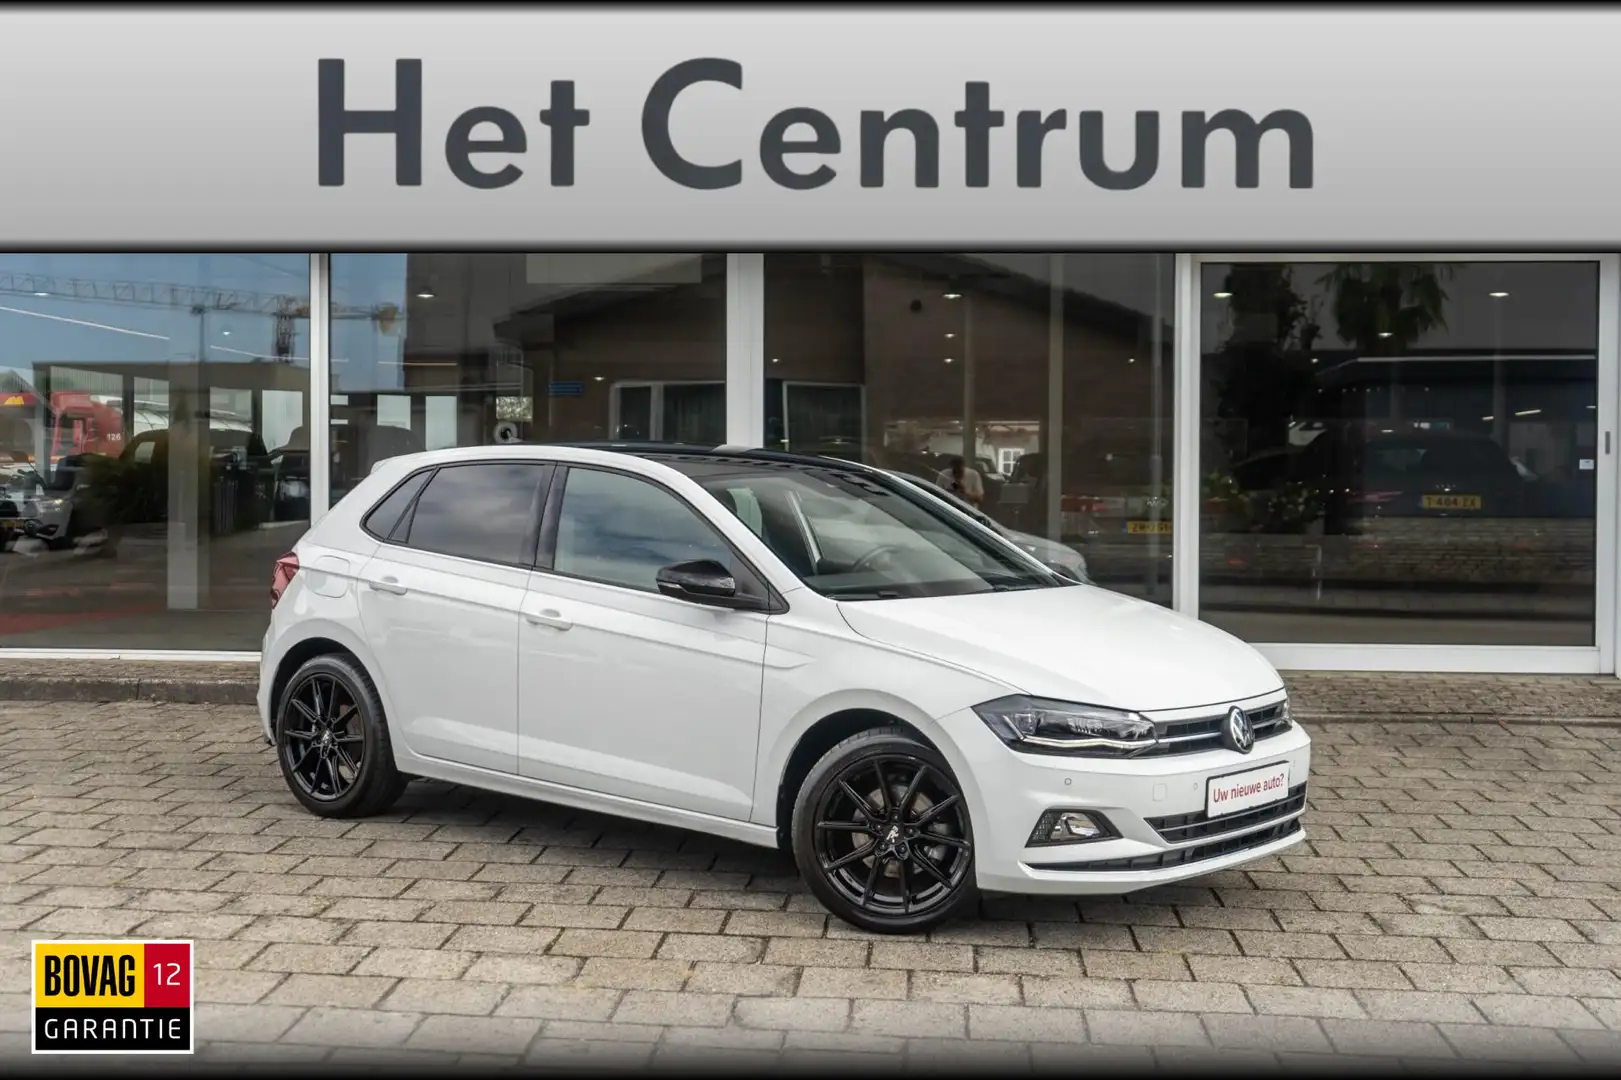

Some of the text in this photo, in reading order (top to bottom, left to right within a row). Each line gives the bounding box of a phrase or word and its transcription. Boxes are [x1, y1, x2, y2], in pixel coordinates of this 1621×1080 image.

[1213, 773, 1285, 803] Uw nieuwe auto?
